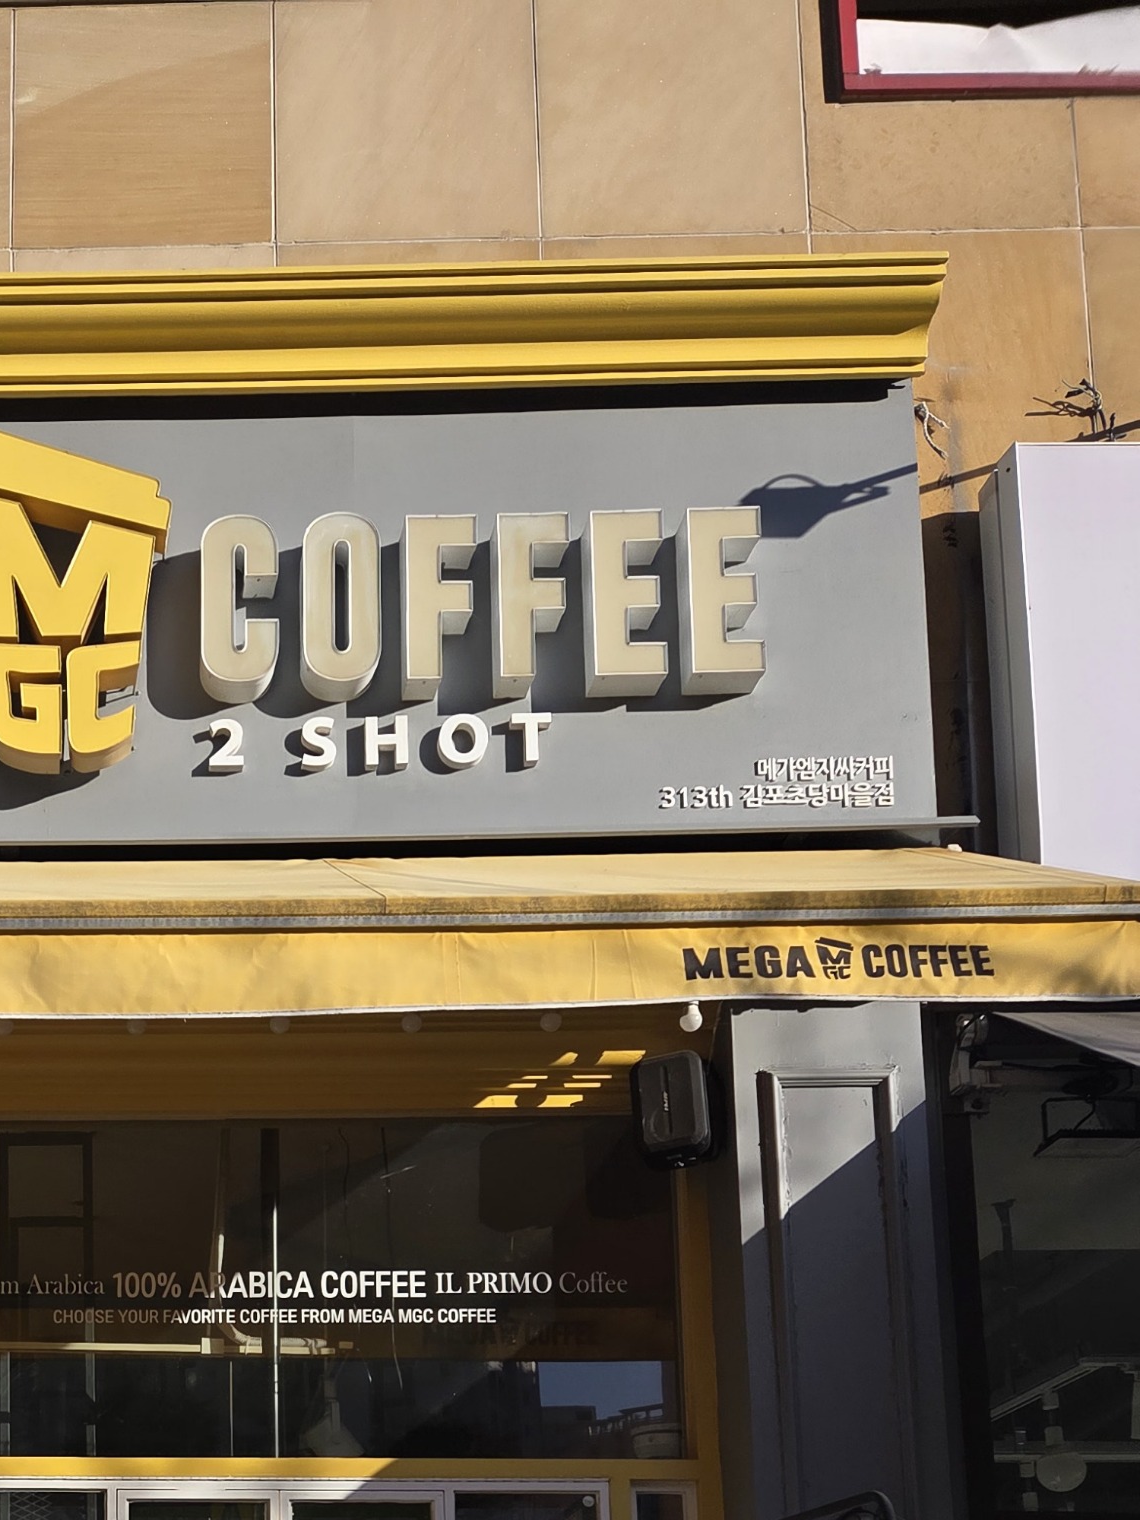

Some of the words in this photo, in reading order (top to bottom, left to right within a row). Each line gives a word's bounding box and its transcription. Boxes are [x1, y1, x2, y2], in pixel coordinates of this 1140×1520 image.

[200, 506, 768, 703] COFFEE
[207, 717, 245, 773] 2
[300, 711, 553, 772] SHOT
[756, 755, 894, 781] 메가엠지씨커피
[659, 784, 734, 809] 313th
[742, 781, 895, 808] 김포초당마을점
[682, 945, 816, 981] MEGA
[862, 944, 995, 979] COFFEE
[27, 1273, 106, 1296] Arabica
[112, 1271, 182, 1299] 100%
[189, 1270, 315, 1299] ARABICA
[320, 1270, 427, 1299] COFFEE
[435, 1271, 462, 1295] IL
[466, 1271, 553, 1295] PRIMO
[559, 1271, 629, 1295] Coffee
[53, 1308, 115, 1325] CHOOSE
[118, 1308, 159, 1325] YOUR
[163, 1308, 237, 1325] FAVORITE
[240, 1308, 298, 1325] COFFEE
[301, 1307, 345, 1324] FROM
[348, 1307, 395, 1324] MEGA
[398, 1307, 434, 1324] MGC
[437, 1307, 497, 1324] COFFEE
